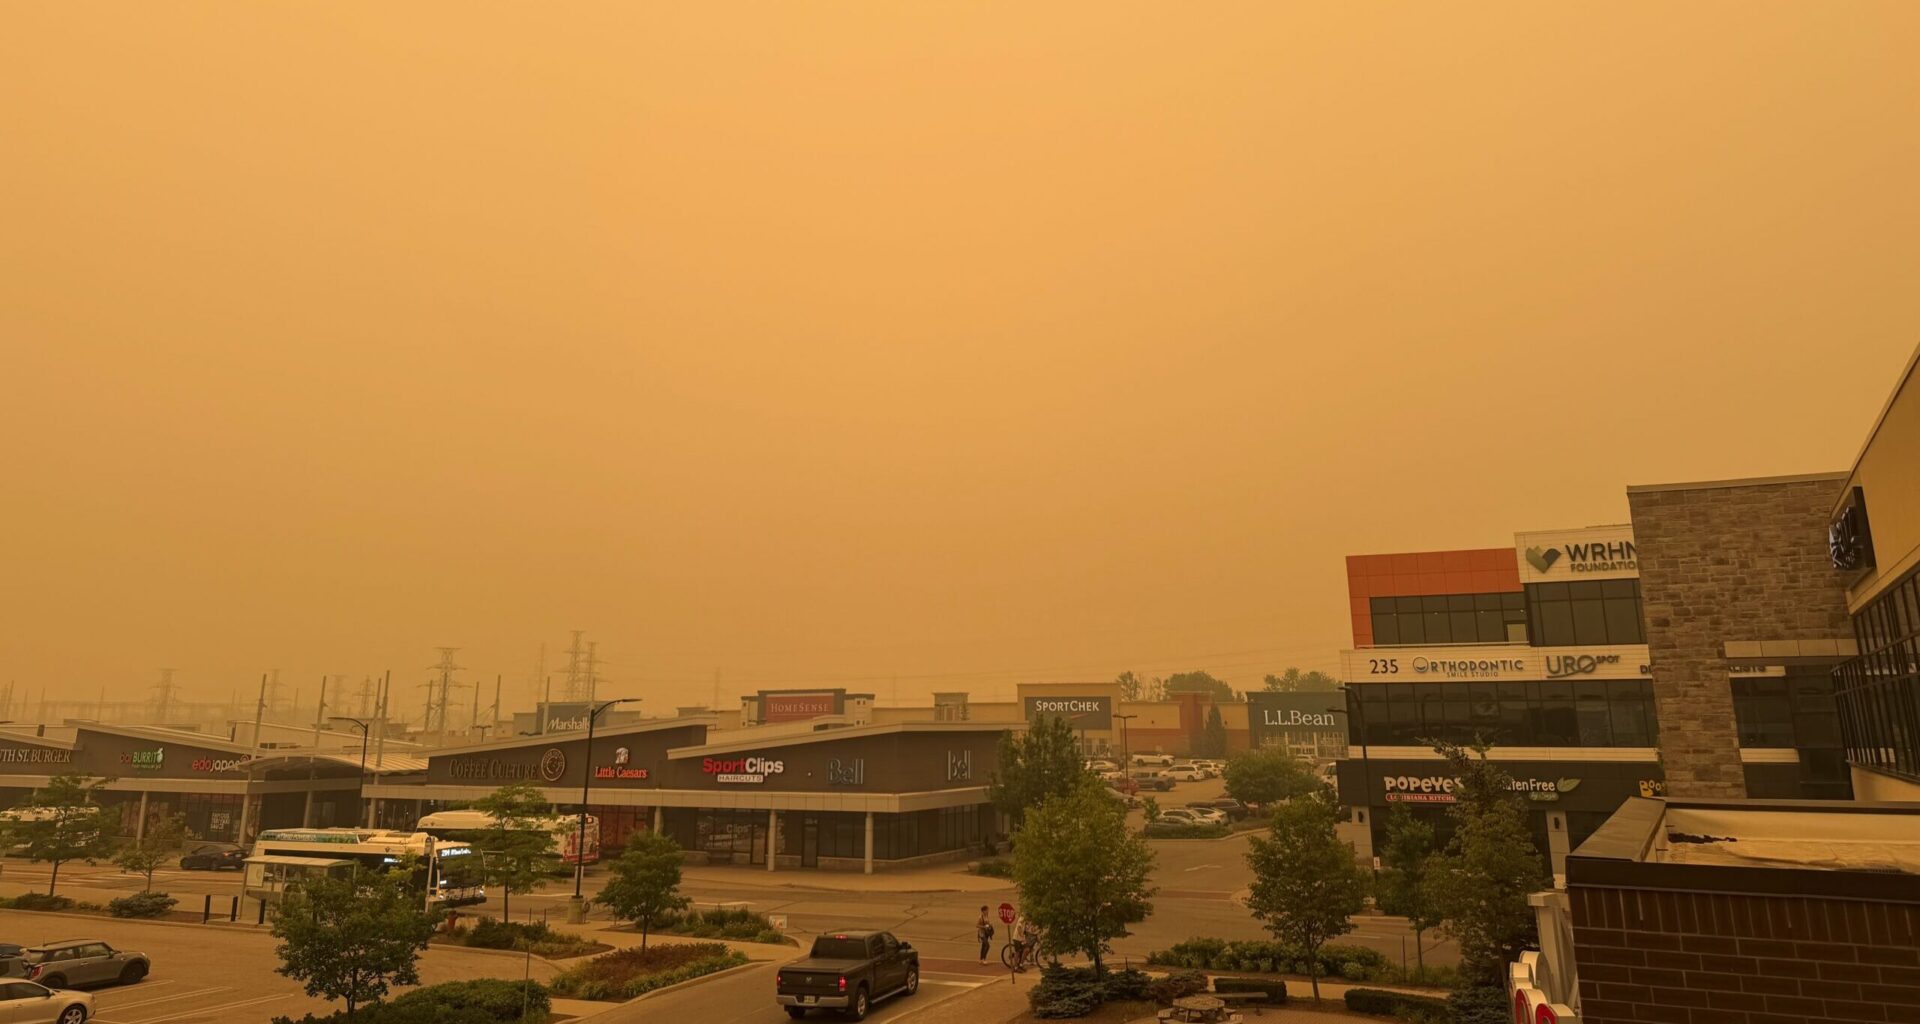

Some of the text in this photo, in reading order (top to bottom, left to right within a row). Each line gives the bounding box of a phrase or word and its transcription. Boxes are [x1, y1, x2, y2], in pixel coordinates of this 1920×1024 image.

[1565, 541, 1637, 562] WRHN
[1570, 561, 1637, 573] FOUNDATIO
[1369, 659, 1399, 674] 235
[1413, 657, 1524, 674] ORTHODONTIC
[1035, 700, 1100, 712] SPORTCHEK
[1264, 710, 1335, 726] L.L.Bean
[0, 749, 15, 762] TH
[31, 749, 72, 763] BURGER
[449, 759, 487, 778] COFFEE
[490, 759, 538, 779] CULTURE
[595, 765, 648, 779] Little Caesars
[703, 757, 784, 777] SportClips
[827, 758, 864, 785] Bell
[947, 750, 970, 780] Bell
[999, 908, 1014, 919] STOP
